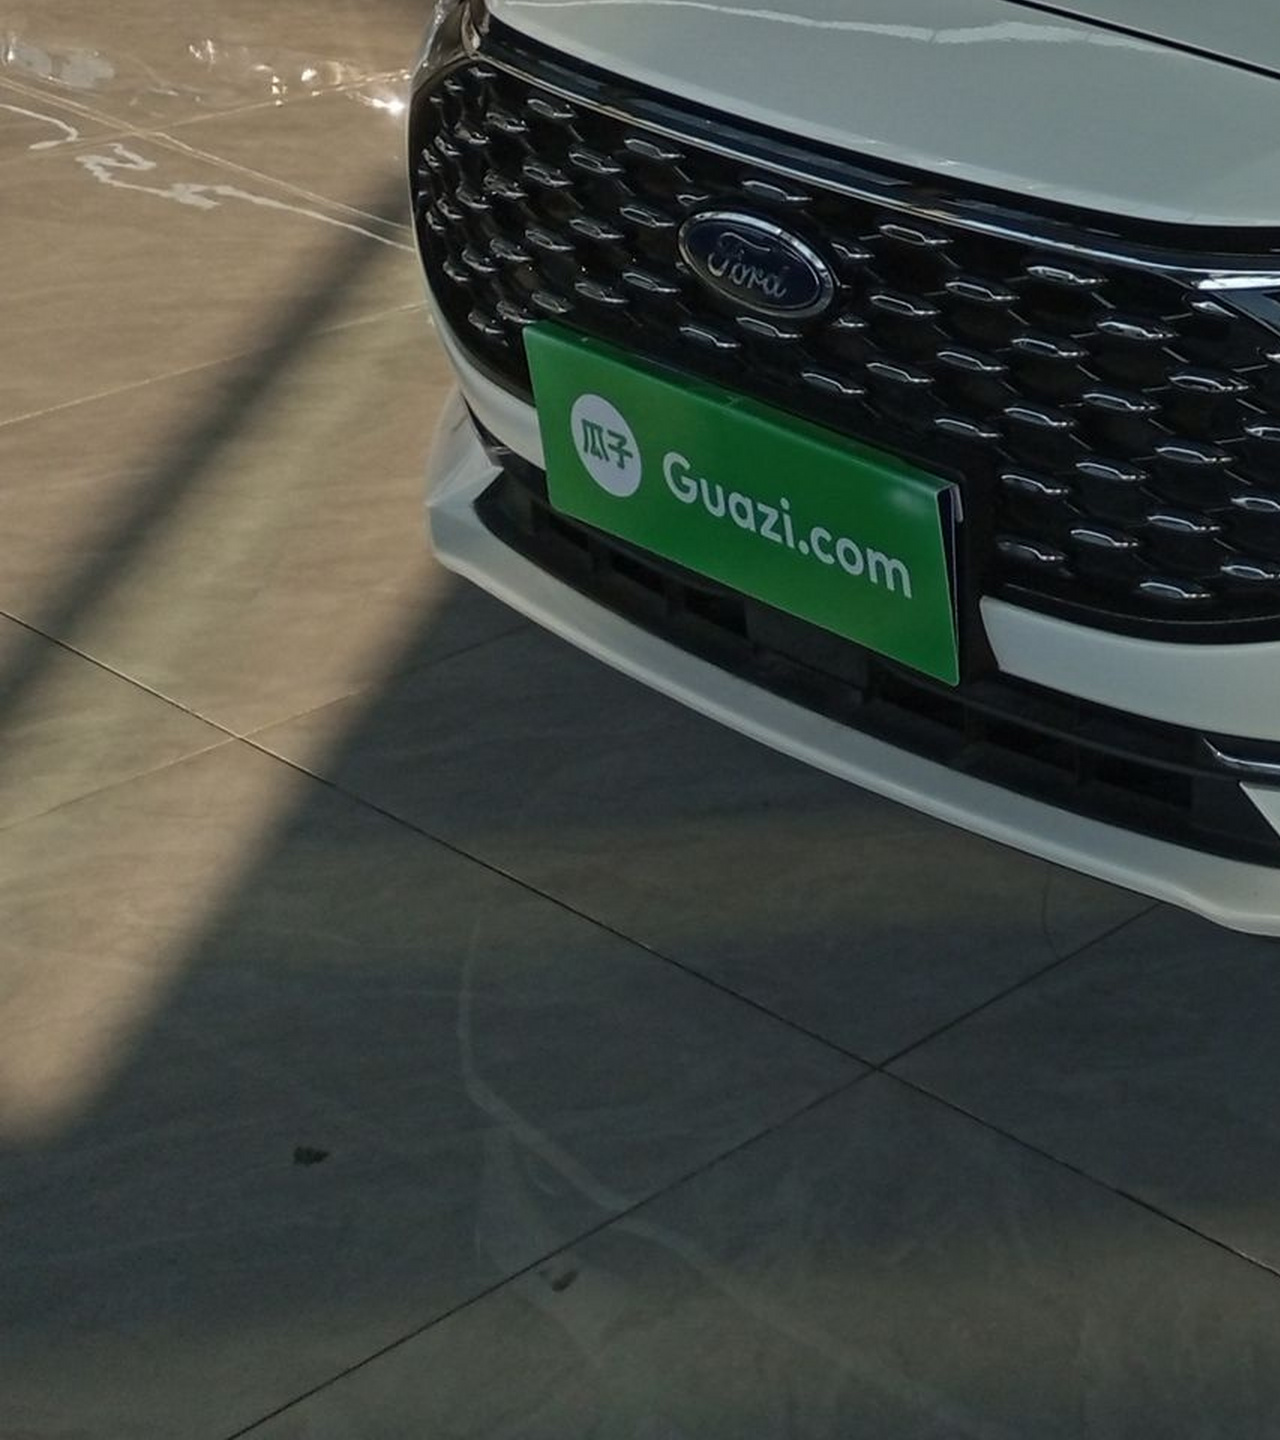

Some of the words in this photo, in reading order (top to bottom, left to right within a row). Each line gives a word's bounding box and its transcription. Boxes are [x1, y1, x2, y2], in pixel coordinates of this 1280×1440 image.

[705, 231, 788, 299] Ford
[580, 417, 634, 471] 瓜子
[661, 452, 914, 600] Guazi.com
